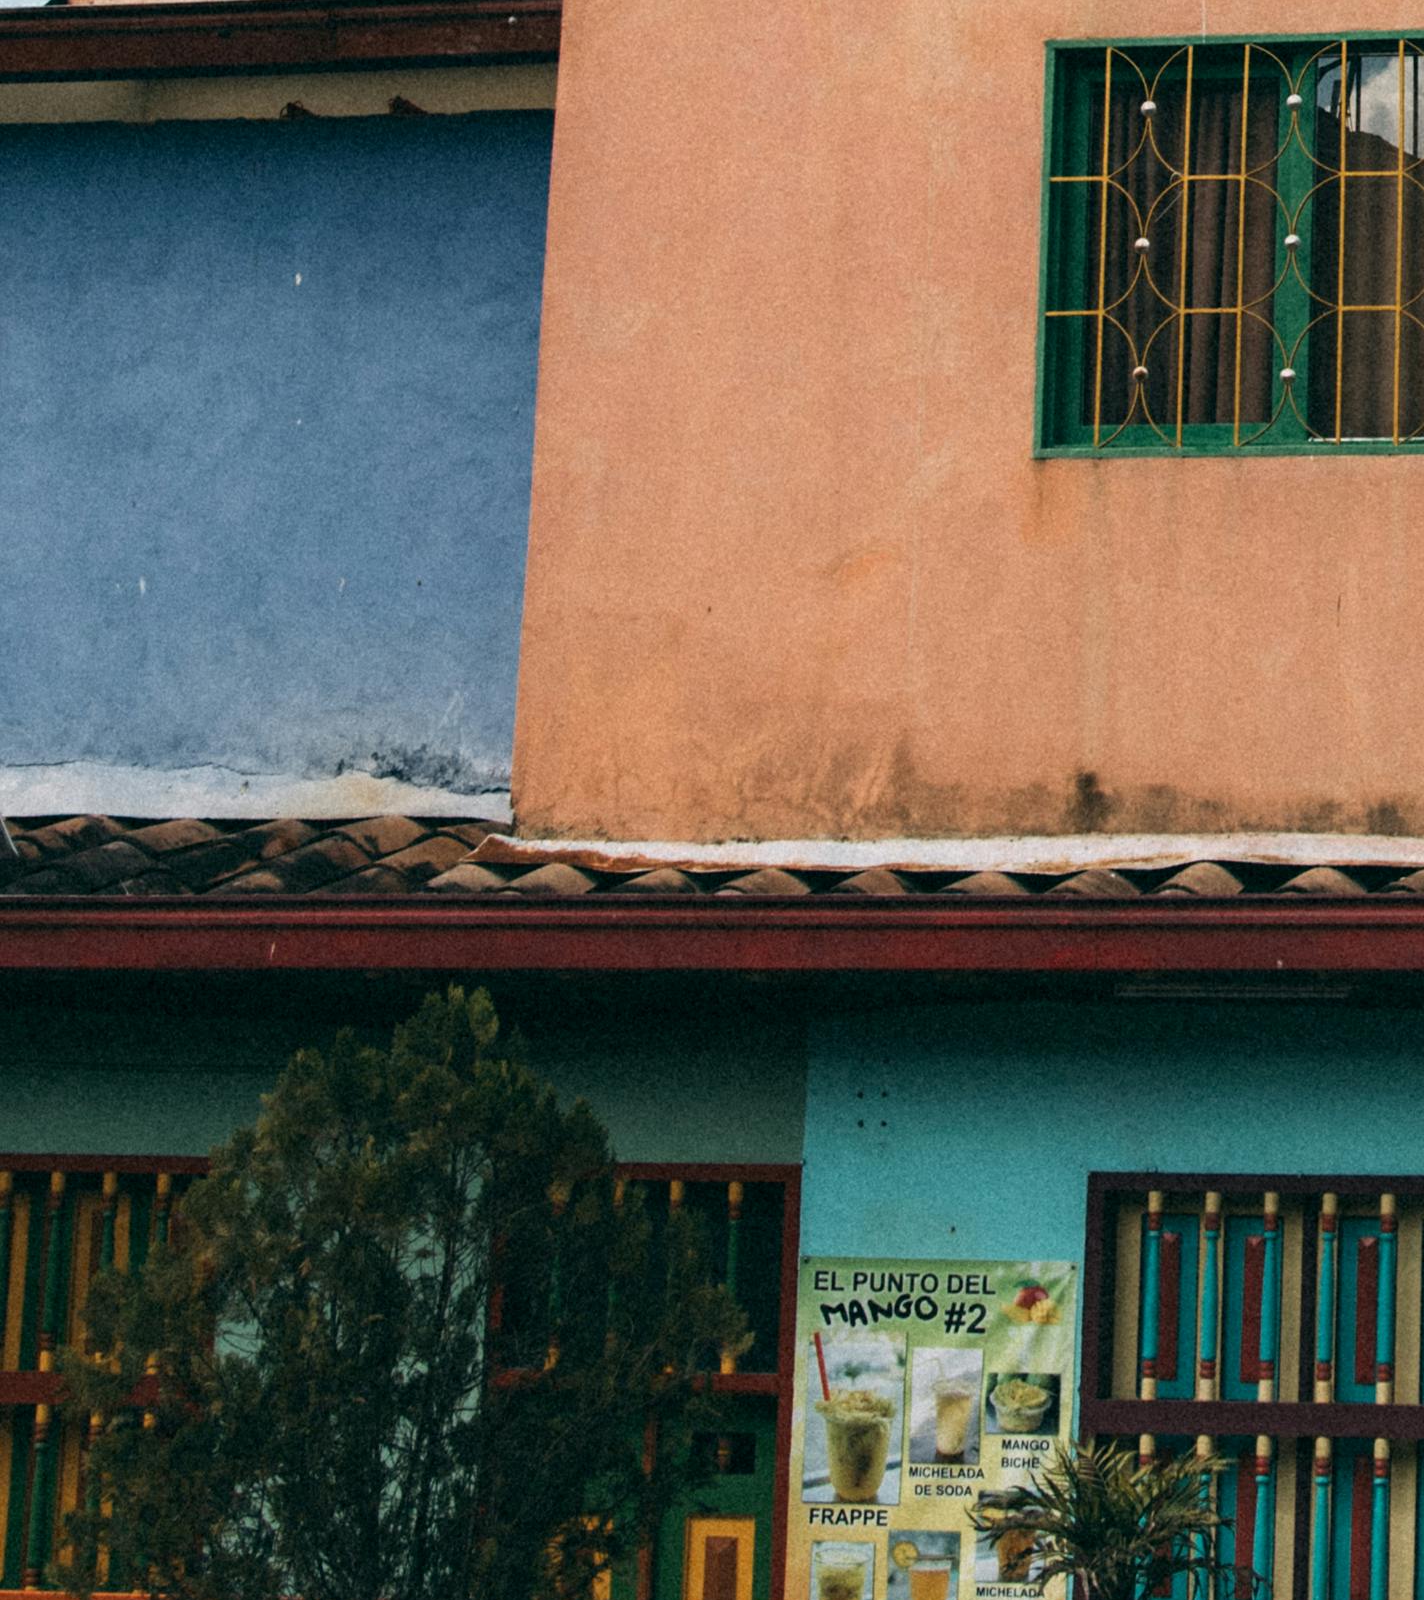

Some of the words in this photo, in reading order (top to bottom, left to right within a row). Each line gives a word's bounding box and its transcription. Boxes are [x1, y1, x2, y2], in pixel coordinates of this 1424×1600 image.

[814, 1270, 845, 1291] EL
[852, 1271, 940, 1295] PUNTO
[946, 1273, 996, 1296] DEL
[819, 1293, 939, 1327] MANGO
[943, 1301, 988, 1335] #2
[1001, 1438, 1050, 1452] MANGO
[1000, 1456, 1041, 1469] BICHE
[908, 1466, 985, 1480] MICHELADA
[913, 1483, 934, 1497] DE
[936, 1484, 973, 1497] SODA
[807, 1507, 889, 1527] FRAPPE
